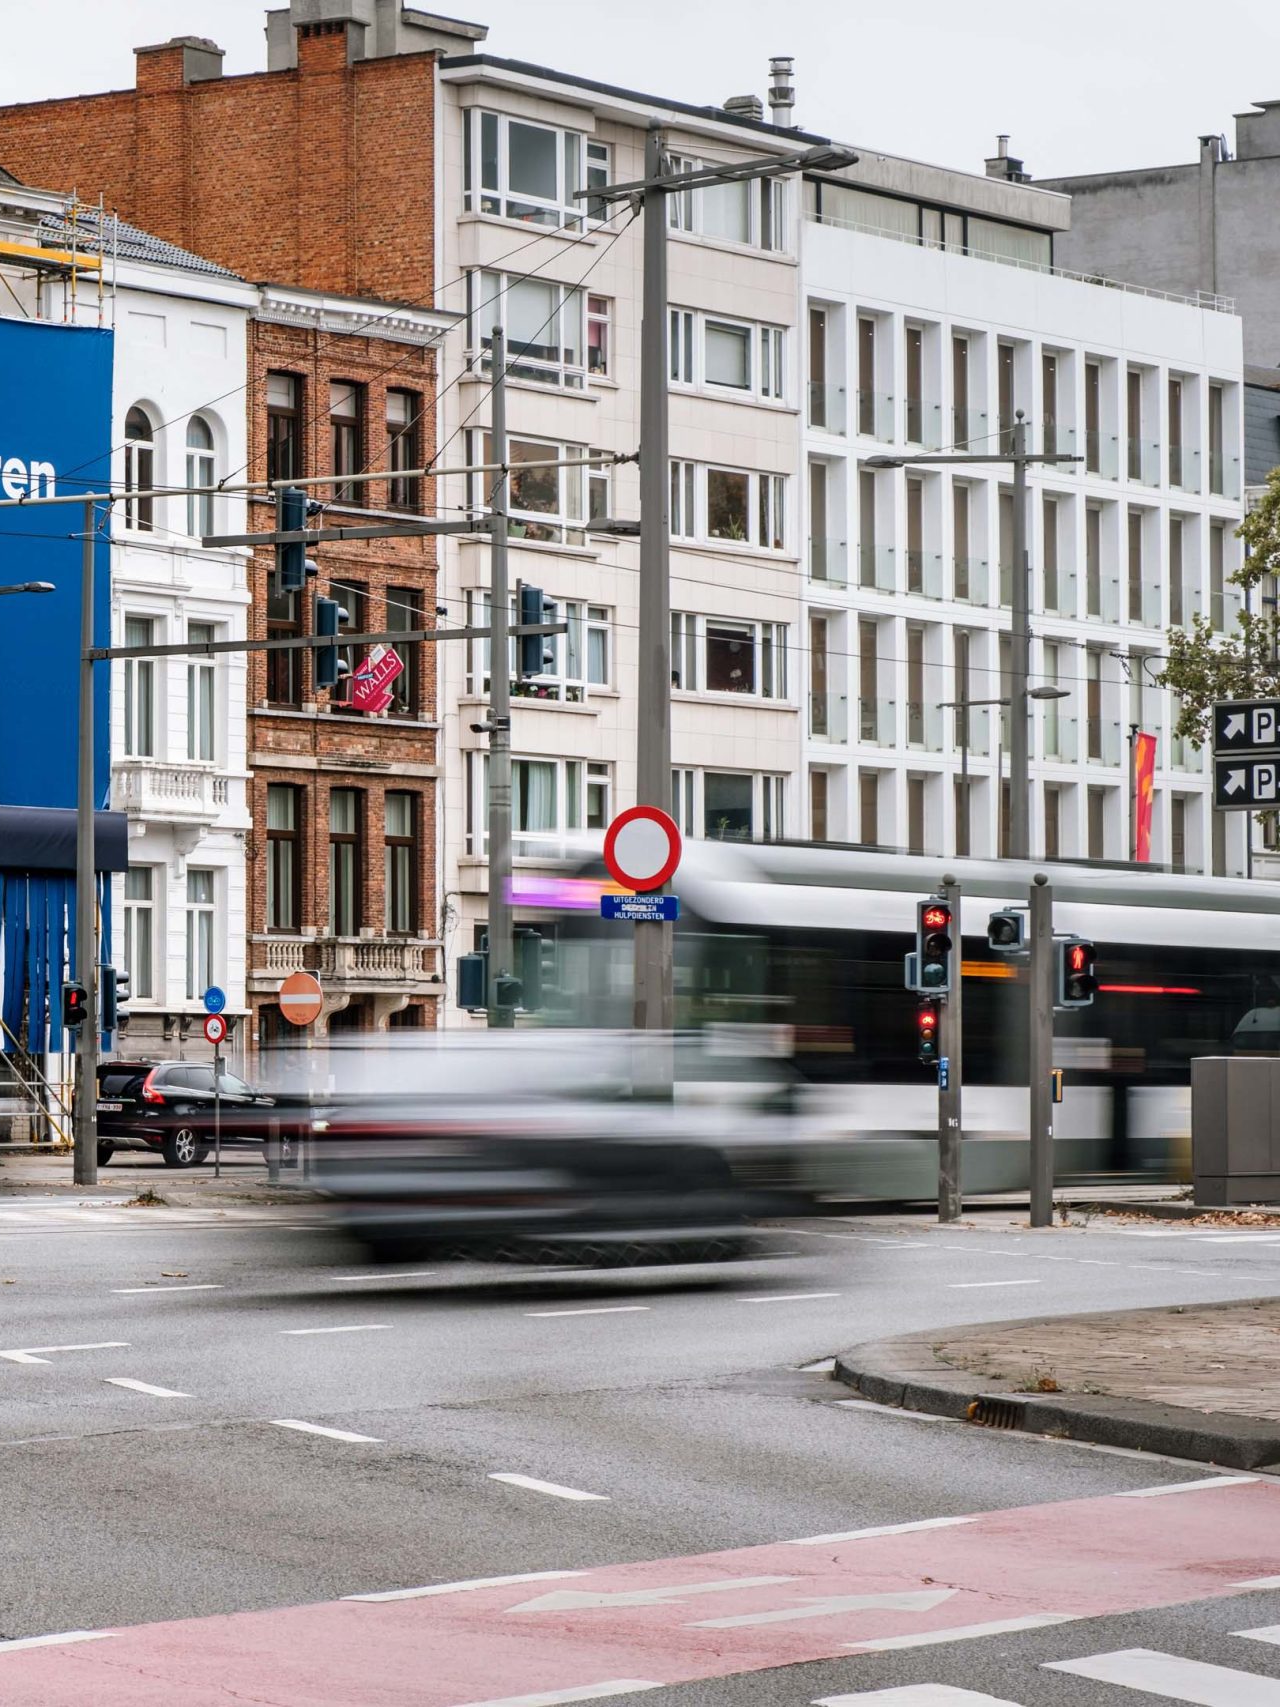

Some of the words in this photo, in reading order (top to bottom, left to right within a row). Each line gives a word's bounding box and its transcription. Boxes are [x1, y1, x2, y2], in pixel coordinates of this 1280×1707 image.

[355, 653, 396, 700] WALLS
[1258, 713, 1271, 739] P
[1258, 769, 1272, 796] P
[615, 912, 664, 920] HULPDIENSTEN
